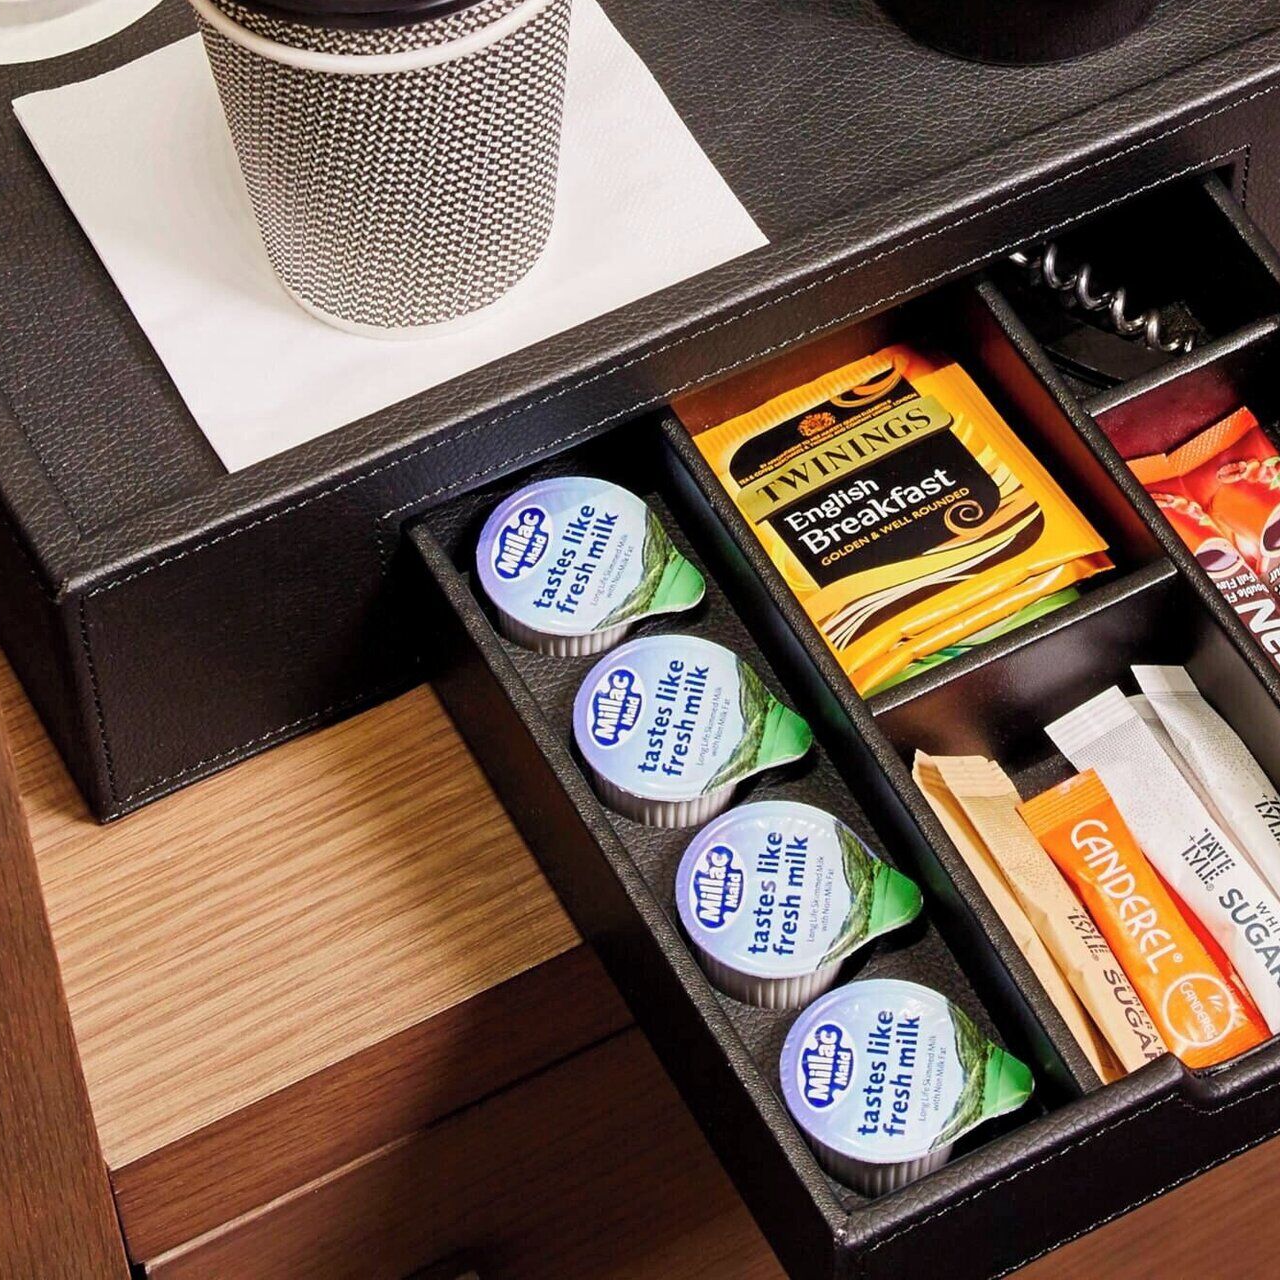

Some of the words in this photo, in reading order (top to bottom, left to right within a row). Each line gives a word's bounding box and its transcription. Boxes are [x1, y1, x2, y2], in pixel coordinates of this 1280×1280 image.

[756, 407, 931, 503] TWININGS
[784, 480, 880, 532] English
[798, 469, 956, 555] Breakfast
[821, 536, 870, 566] GOLDEN
[870, 531, 880, 541] &
[879, 517, 913, 535] WELL
[912, 487, 970, 520] ROUNDED
[496, 512, 539, 574] Millac
[524, 534, 545, 565] Maid
[533, 549, 576, 609] tastes
[562, 505, 595, 544] like
[556, 561, 596, 614] fresh
[588, 512, 618, 559] milk
[588, 587, 604, 607] Long
[596, 574, 607, 589] Life
[614, 532, 628, 549] Milk
[603, 582, 616, 598] with
[616, 555, 628, 571] Milk
[622, 544, 633, 557] Fat
[1240, 572, 1257, 587] Full
[595, 675, 630, 740] Millac
[621, 696, 641, 726] Maid
[711, 685, 722, 701] Milk
[721, 697, 730, 710] Fat
[638, 707, 672, 773] tastes
[656, 660, 684, 702] like
[662, 719, 695, 777] fresh
[683, 666, 709, 715] milk
[716, 709, 727, 725] Milk
[694, 745, 707, 766] Long
[700, 732, 710, 746] Life
[708, 739, 719, 756] with
[757, 832, 782, 874] like
[785, 835, 808, 887] milk
[814, 855, 824, 871] Milk
[1181, 844, 1220, 885] LYLE
[1197, 828, 1236, 875] TATE
[699, 854, 728, 921] Millac
[725, 872, 742, 908] Maid
[823, 880, 832, 896] Milk
[825, 868, 834, 879] Fat
[748, 881, 777, 954] tastes
[773, 894, 801, 955] fresh
[805, 923, 816, 942] Long
[808, 908, 817, 922] Life
[819, 914, 828, 931] with
[1180, 982, 1219, 1041] CANDEREL
[867, 1010, 893, 1055] like
[896, 1015, 920, 1067] milk
[926, 1035, 936, 1051] Milk
[937, 1046, 946, 1060] Fat
[807, 1031, 838, 1100] Millac
[834, 1051, 853, 1086] Maid
[934, 1060, 944, 1076] Milk
[858, 1061, 886, 1136] tastes
[883, 1075, 912, 1136] fresh
[916, 1101, 928, 1121] Long
[919, 1085, 929, 1101] Life
[930, 1092, 941, 1110] with
